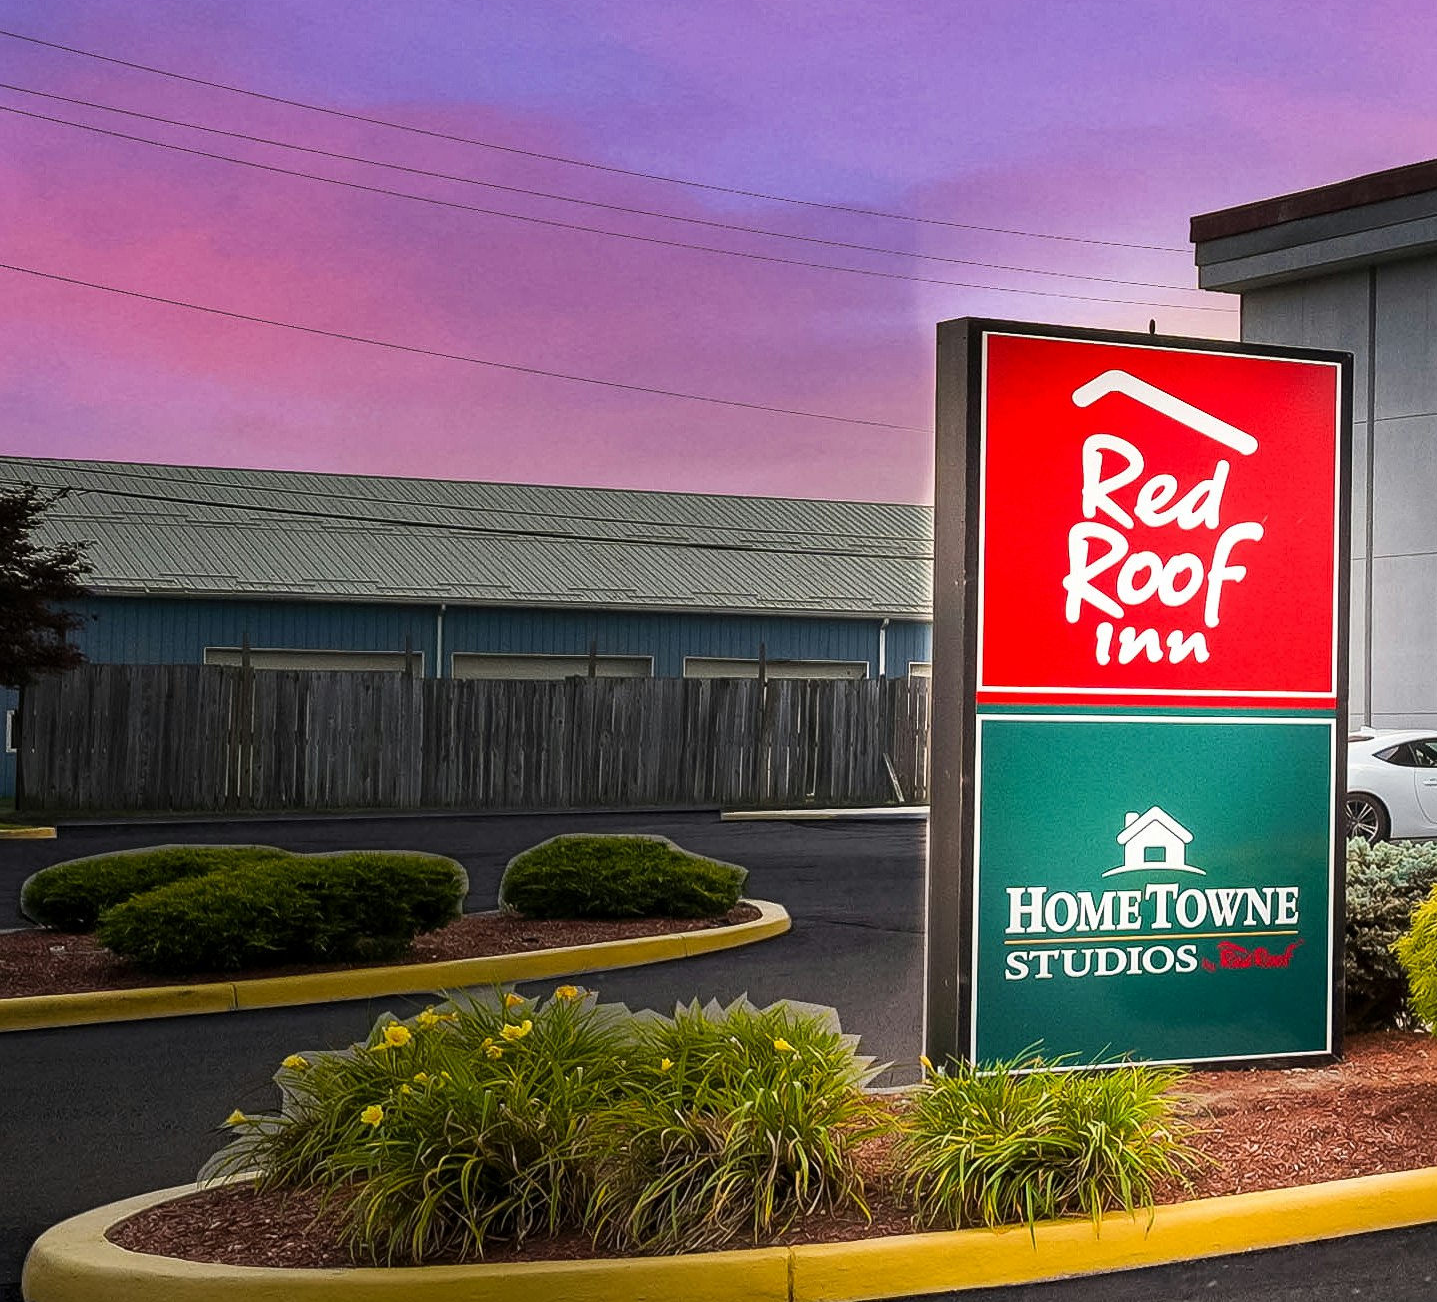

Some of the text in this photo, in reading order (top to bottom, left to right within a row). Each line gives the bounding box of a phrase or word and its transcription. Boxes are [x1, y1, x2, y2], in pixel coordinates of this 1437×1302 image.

[1082, 434, 1230, 531] Red
[1062, 522, 1265, 628] Roof
[1004, 945, 1198, 981] STUDIOS
